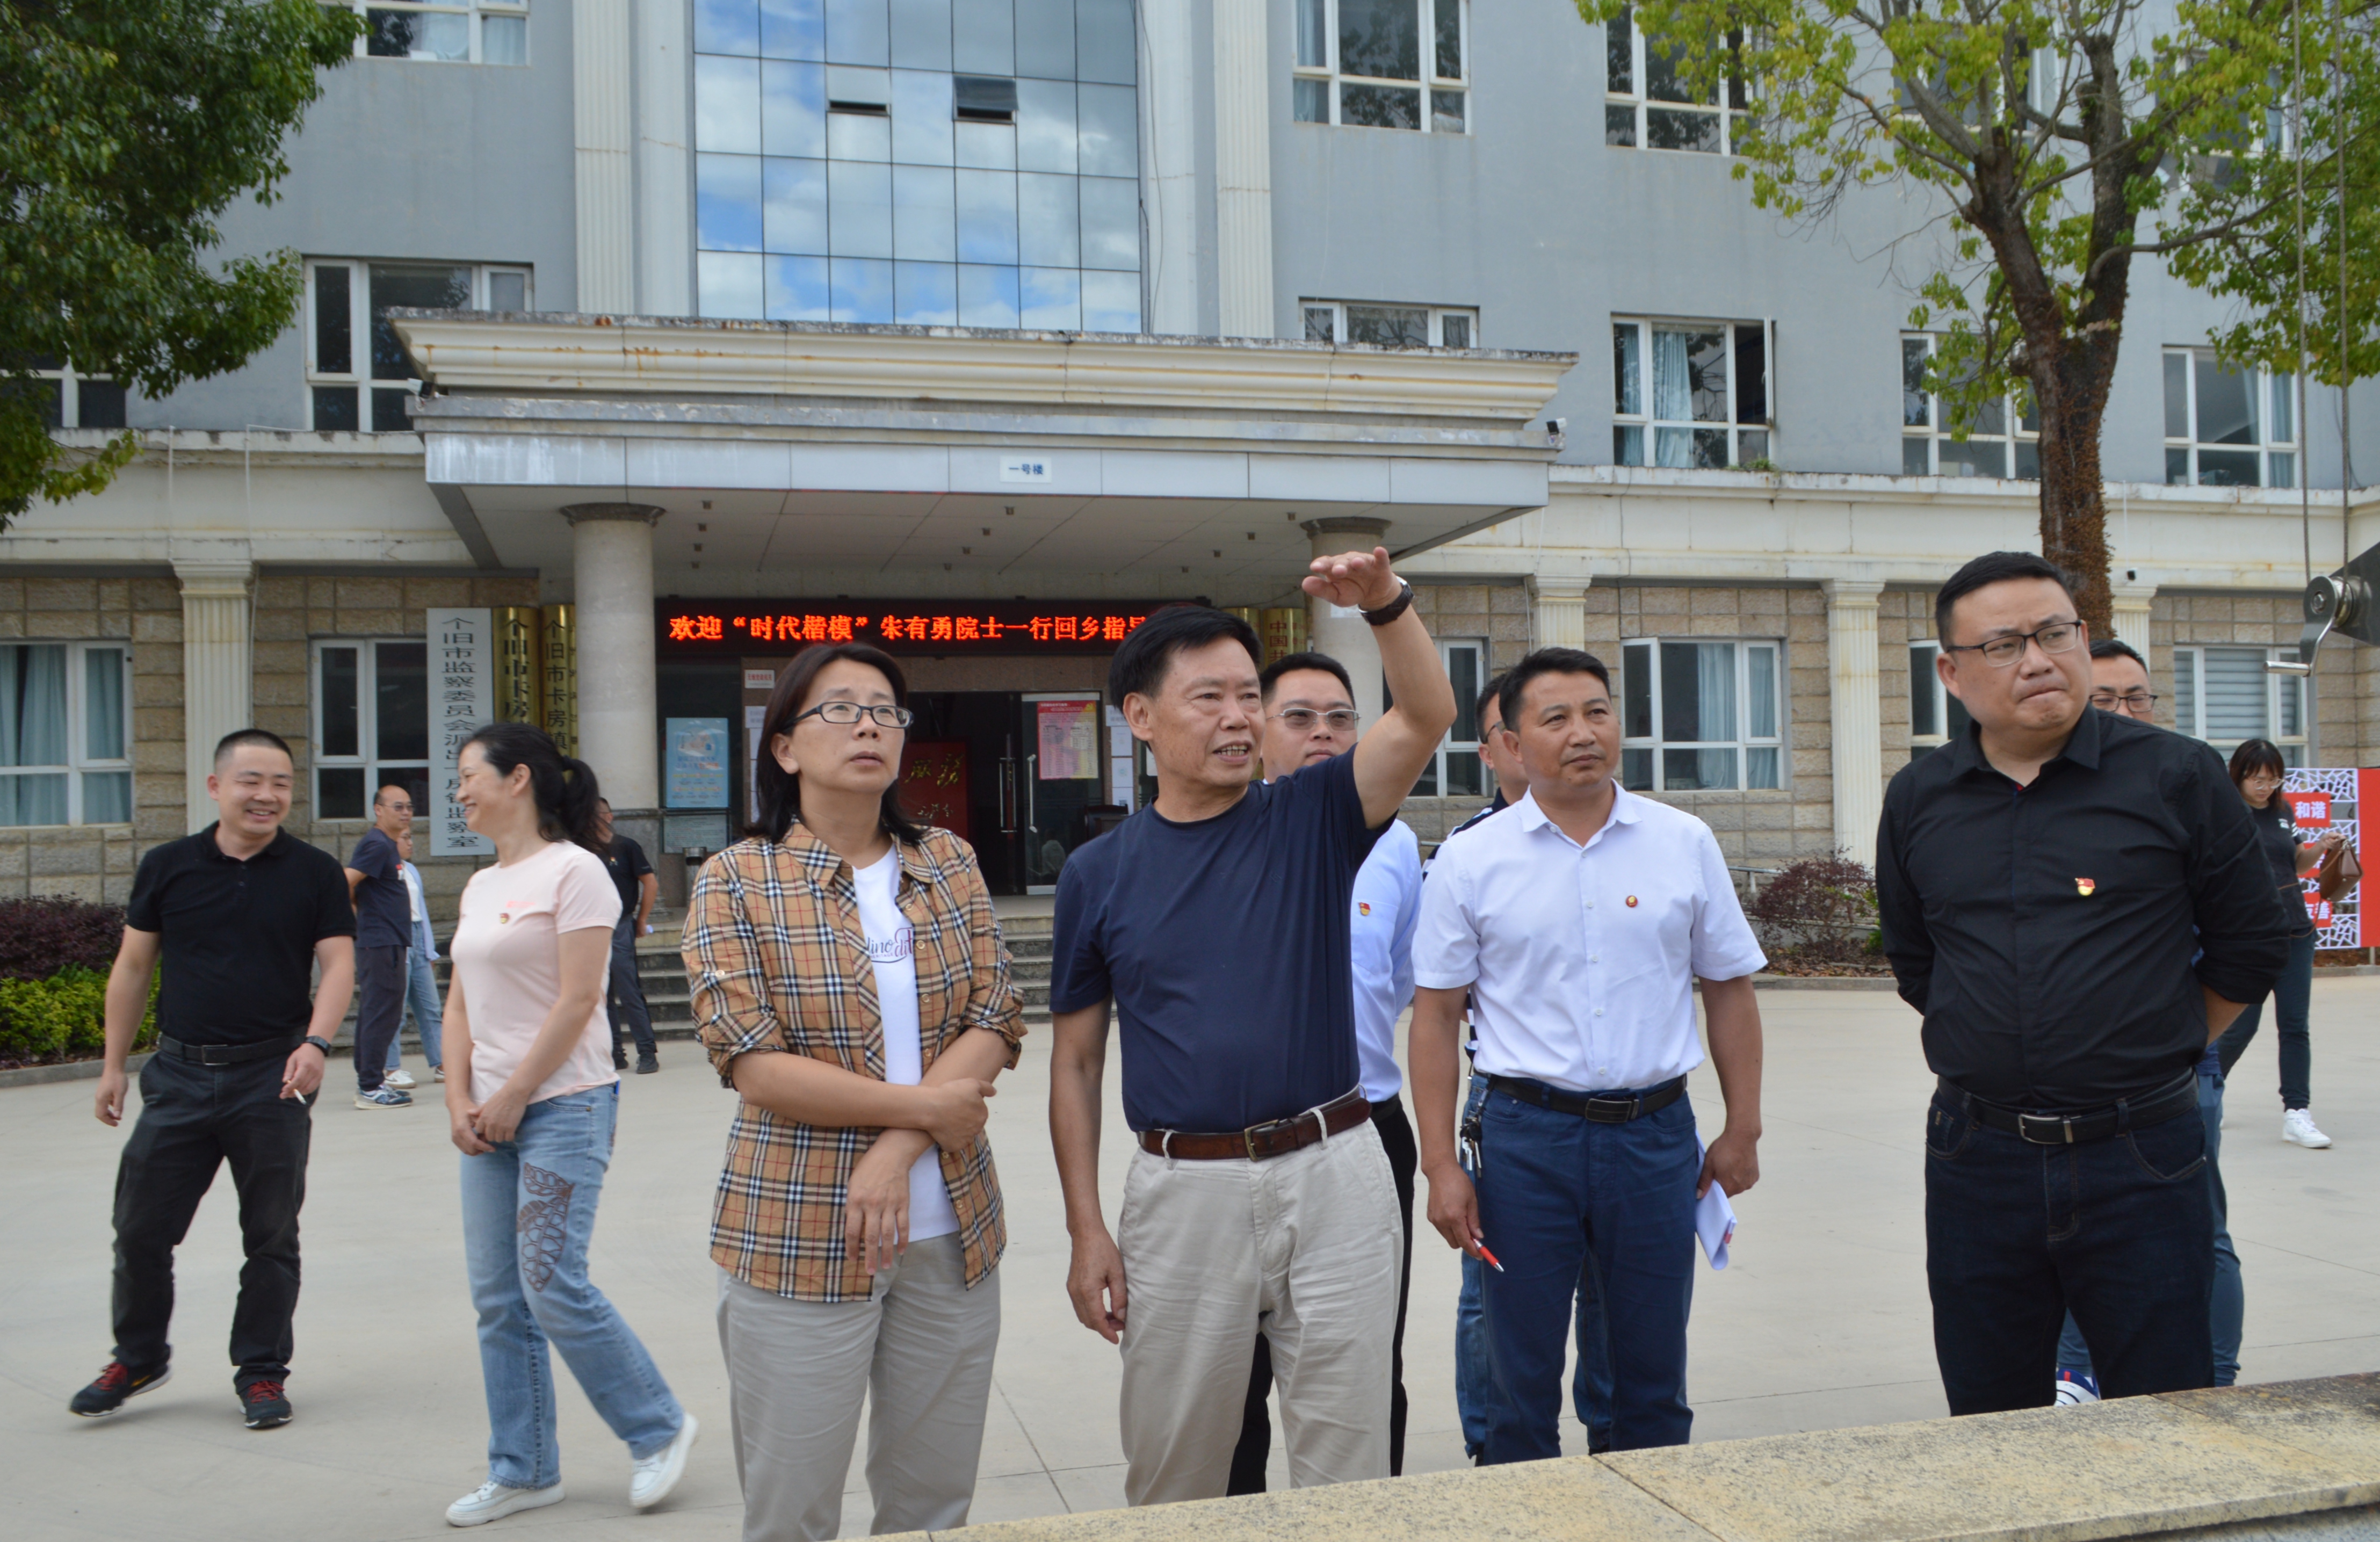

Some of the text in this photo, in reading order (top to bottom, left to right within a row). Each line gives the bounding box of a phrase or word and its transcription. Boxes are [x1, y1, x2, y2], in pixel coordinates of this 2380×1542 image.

[1009, 464, 1043, 475] 一号楼
[501, 619, 531, 723] 个旧市卡房
[2295, 801, 2326, 819] 和谐
[2304, 901, 2331, 920] 友善
